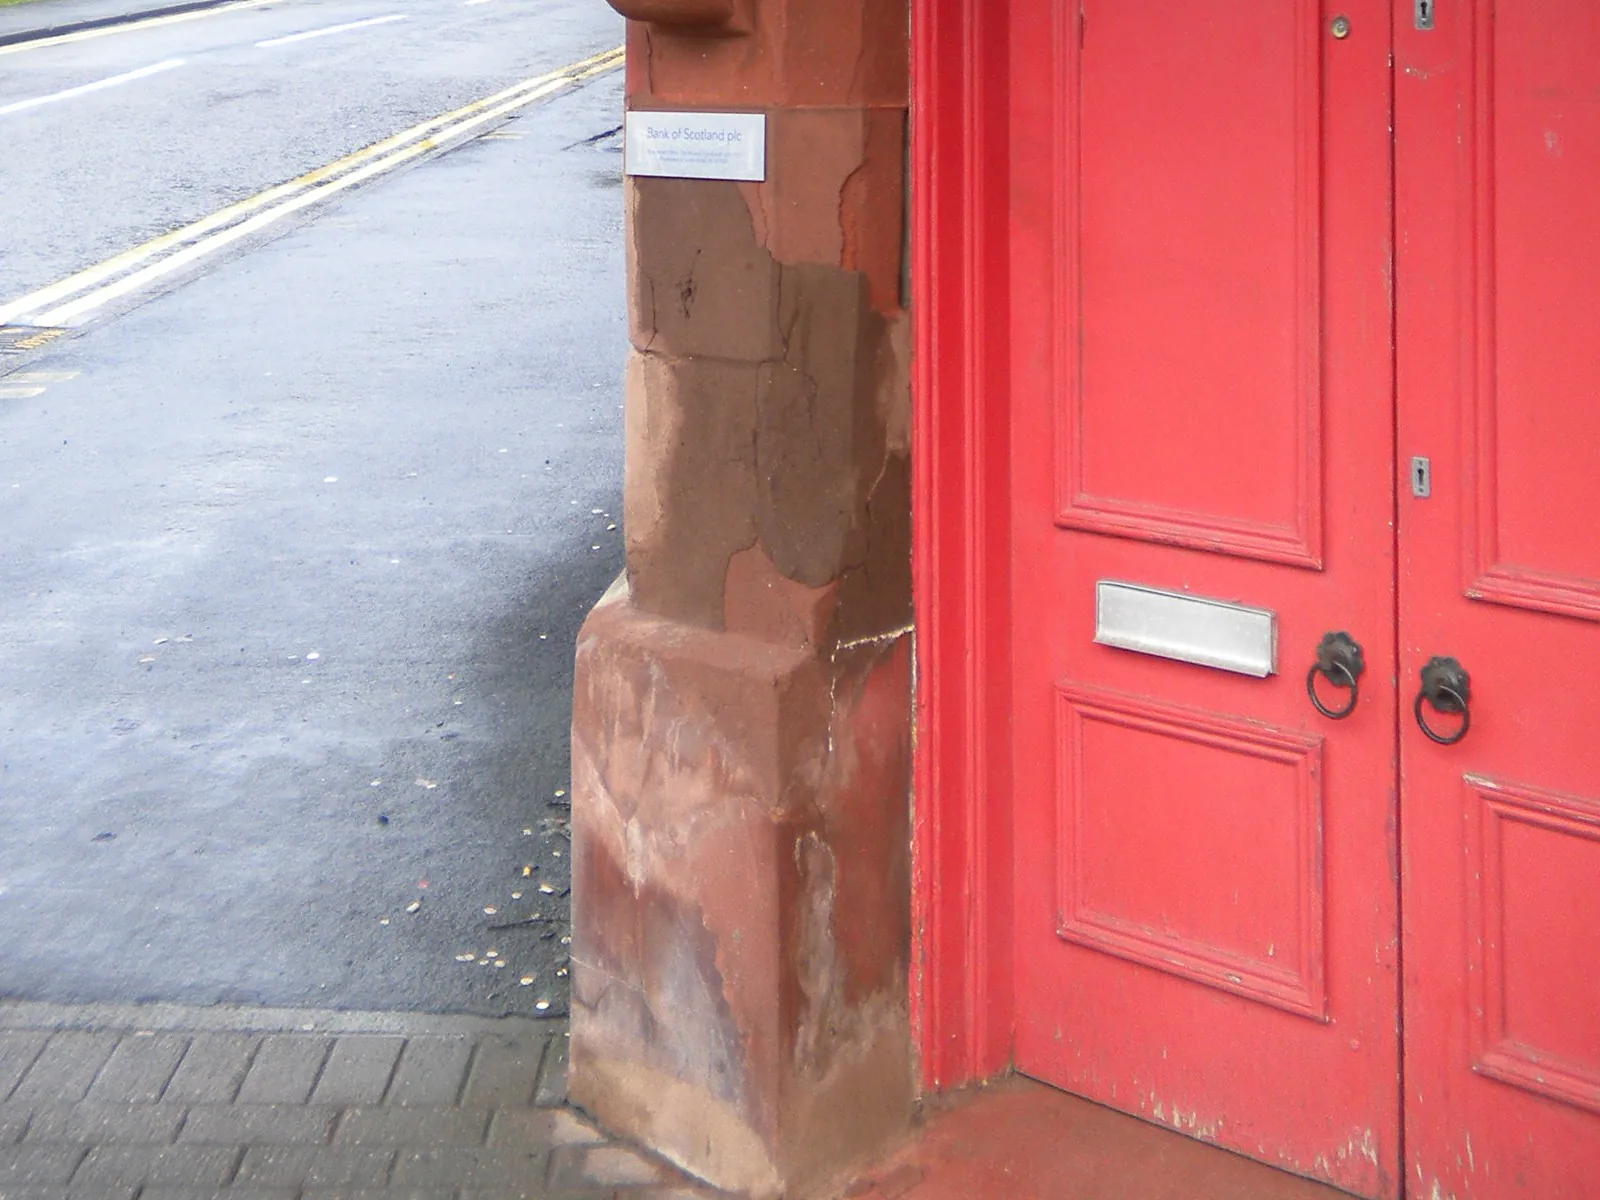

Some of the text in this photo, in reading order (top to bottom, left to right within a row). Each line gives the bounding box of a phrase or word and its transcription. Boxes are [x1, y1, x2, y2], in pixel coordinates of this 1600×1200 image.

[647, 126, 742, 144] Bank of Scotland plc
